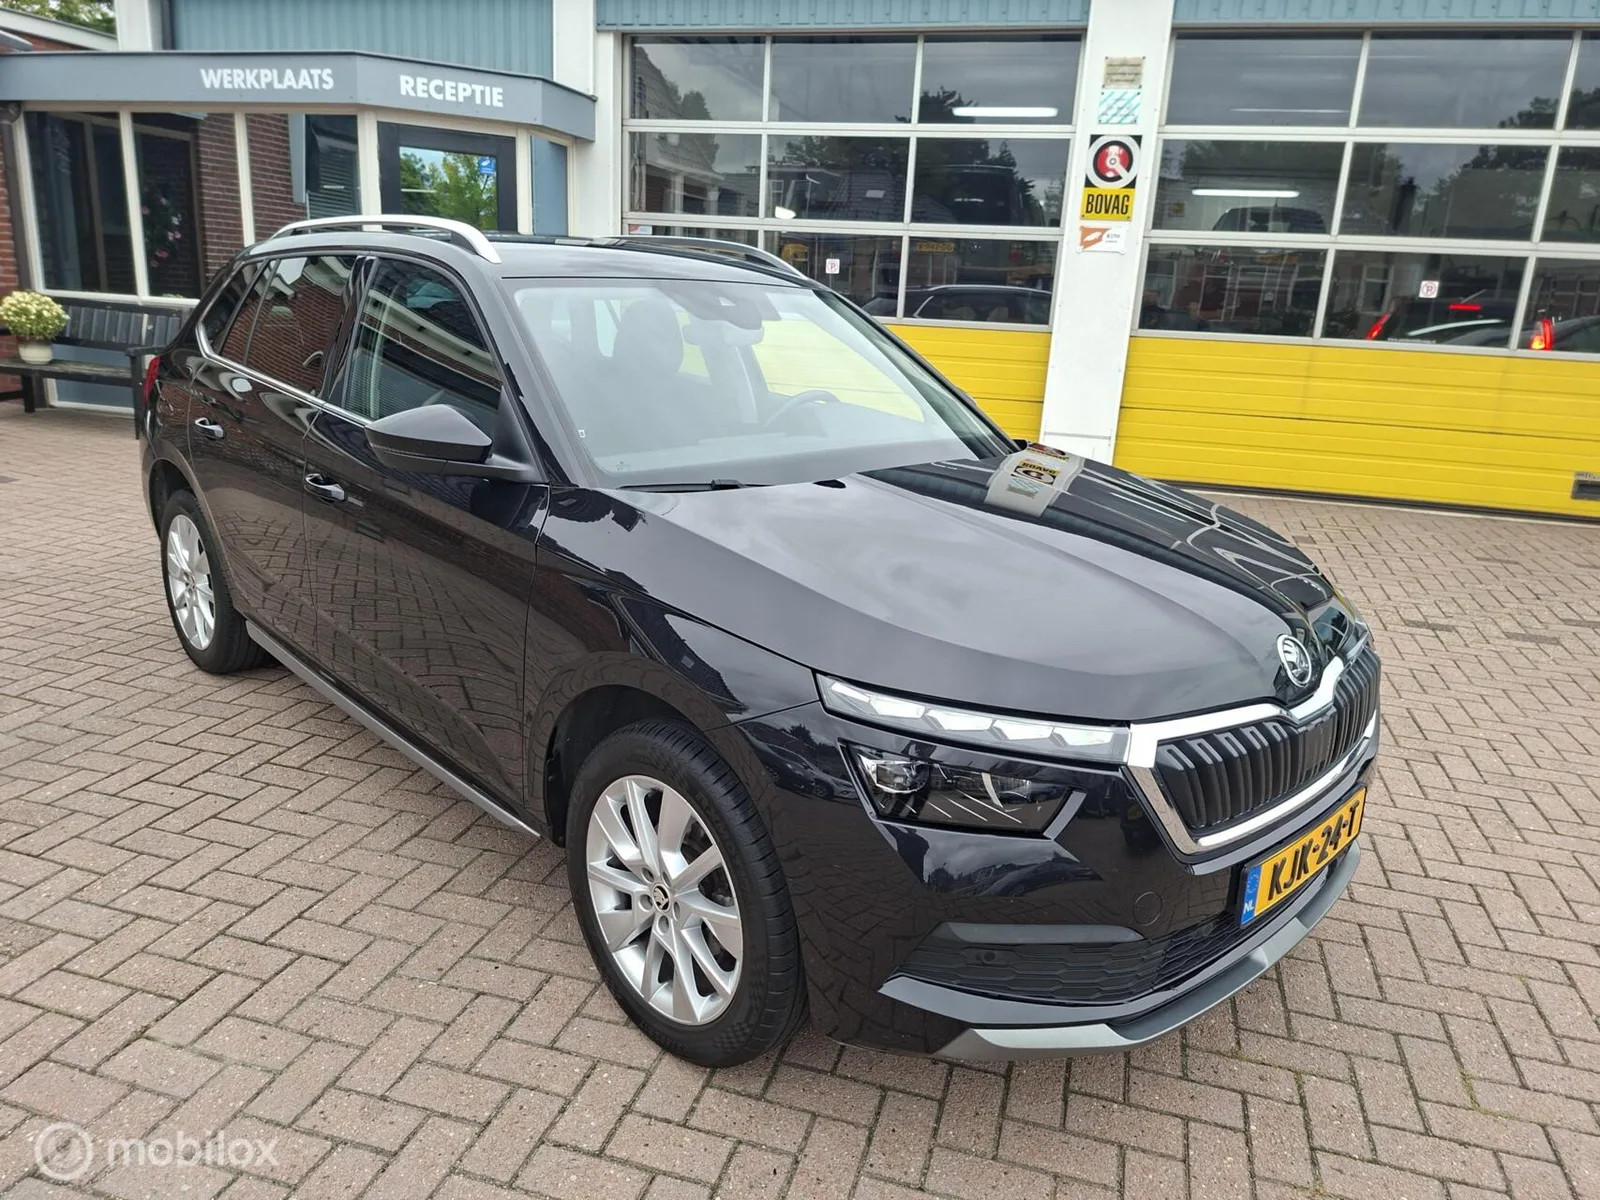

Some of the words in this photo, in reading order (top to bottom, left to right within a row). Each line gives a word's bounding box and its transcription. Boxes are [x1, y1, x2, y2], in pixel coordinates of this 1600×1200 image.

[200, 67, 335, 91] WERKPLAATS
[399, 74, 504, 108] RECEPTIE
[1085, 193, 1130, 215] BOVAG
[1268, 800, 1360, 901] KJK-24-T
[1243, 900, 1255, 914] NL
